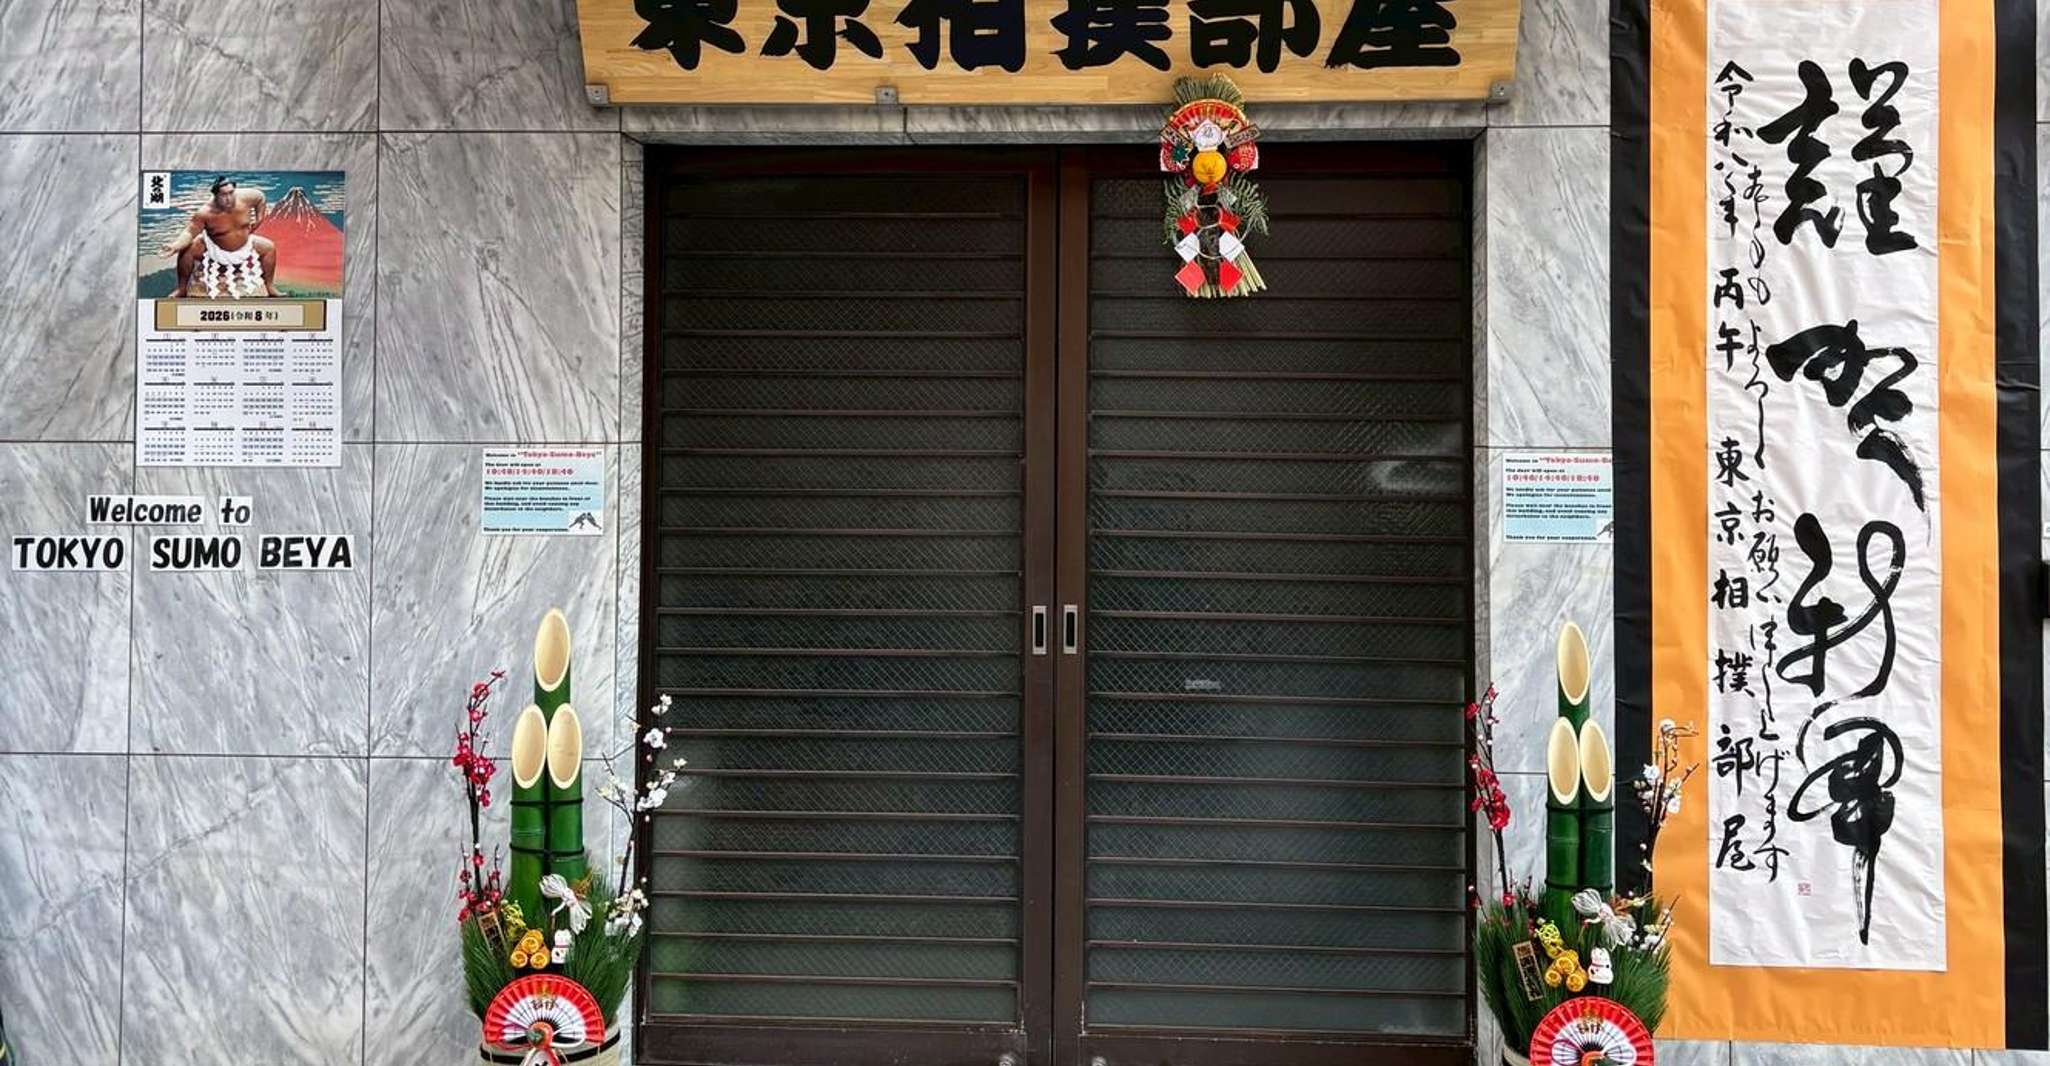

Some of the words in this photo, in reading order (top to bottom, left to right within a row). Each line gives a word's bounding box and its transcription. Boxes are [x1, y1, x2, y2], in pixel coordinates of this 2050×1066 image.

[90, 497, 202, 523] Welcome
[221, 497, 251, 523] to
[14, 537, 124, 569] TOKYO
[152, 537, 241, 569] SUMO
[260, 537, 352, 568] BEYA
[1712, 437, 1756, 871] 東京相撲部屋
